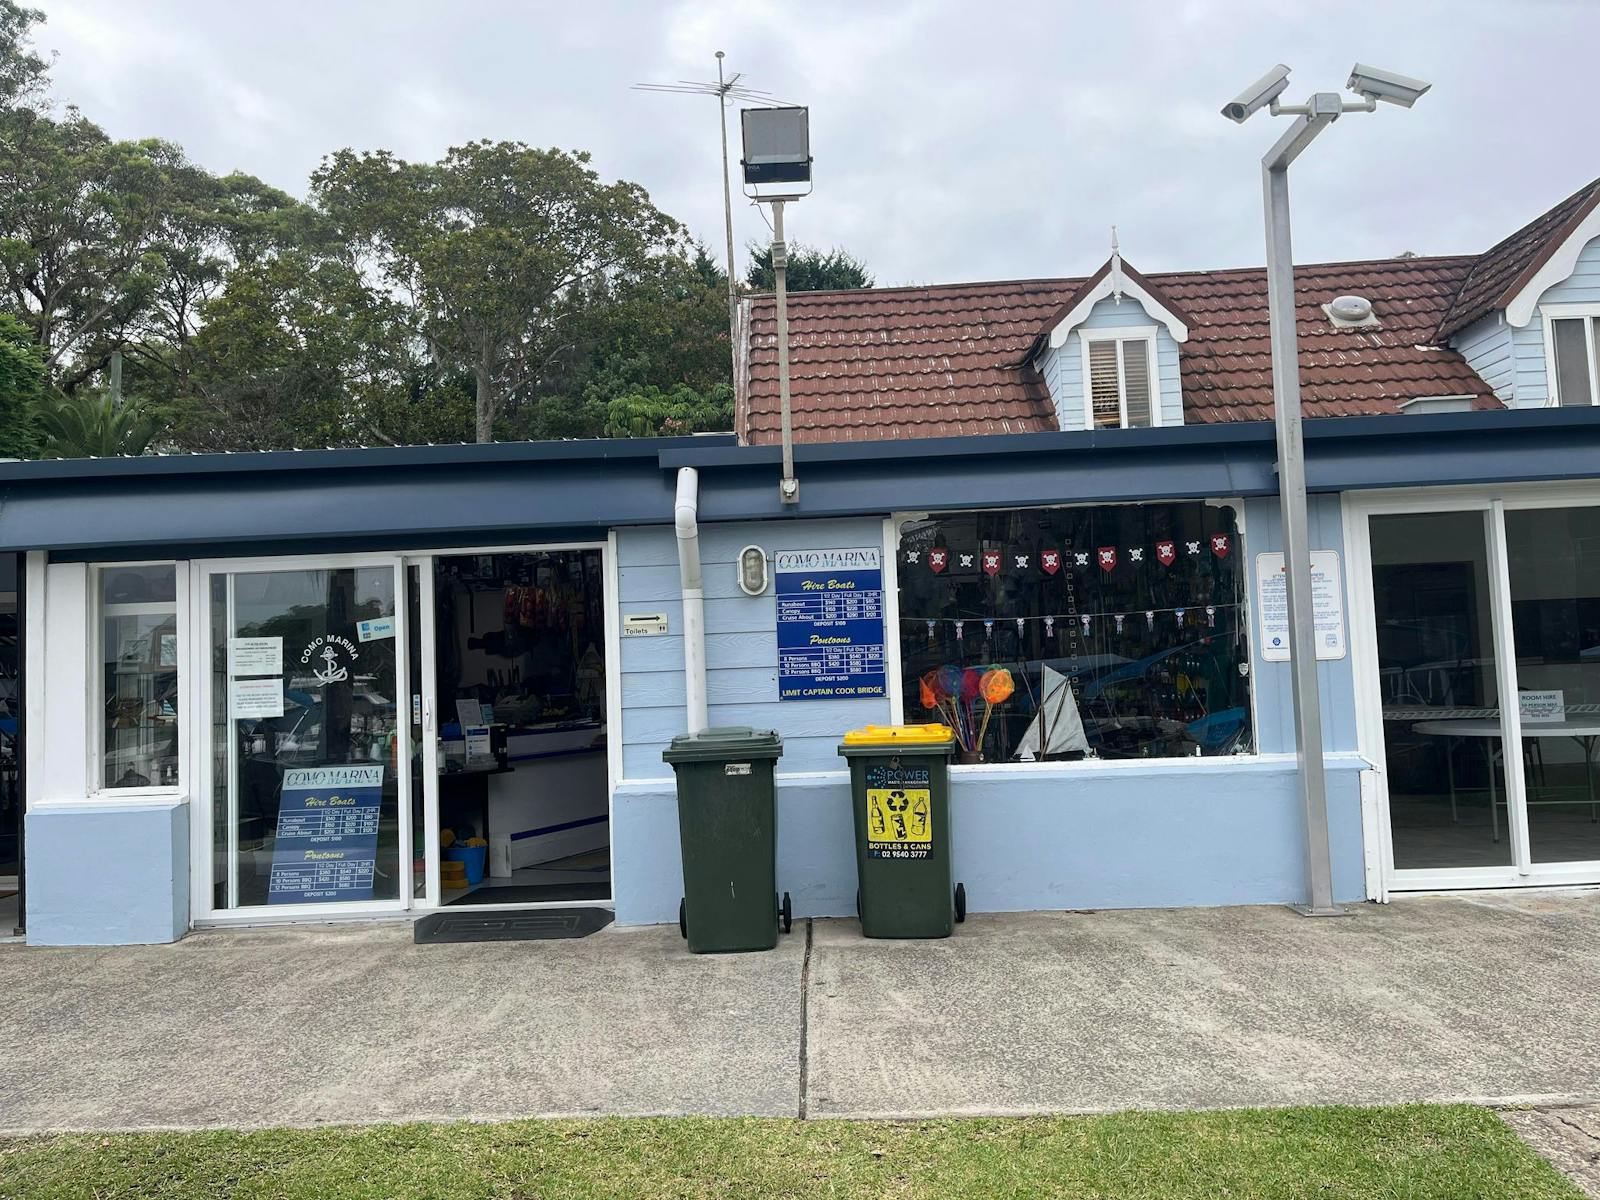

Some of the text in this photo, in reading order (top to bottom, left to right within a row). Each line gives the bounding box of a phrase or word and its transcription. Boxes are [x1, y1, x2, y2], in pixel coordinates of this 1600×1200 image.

[780, 552, 878, 569] COMO MARINA
[801, 580, 855, 590] Hire Boats
[810, 635, 851, 644] Pontoons
[301, 638, 323, 663] COMO
[327, 635, 359, 660] MARINA
[287, 770, 379, 786] COMO MARINA
[887, 771, 929, 780] POWER
[305, 796, 356, 807] Hire Boats
[304, 850, 344, 860] Pontoons
